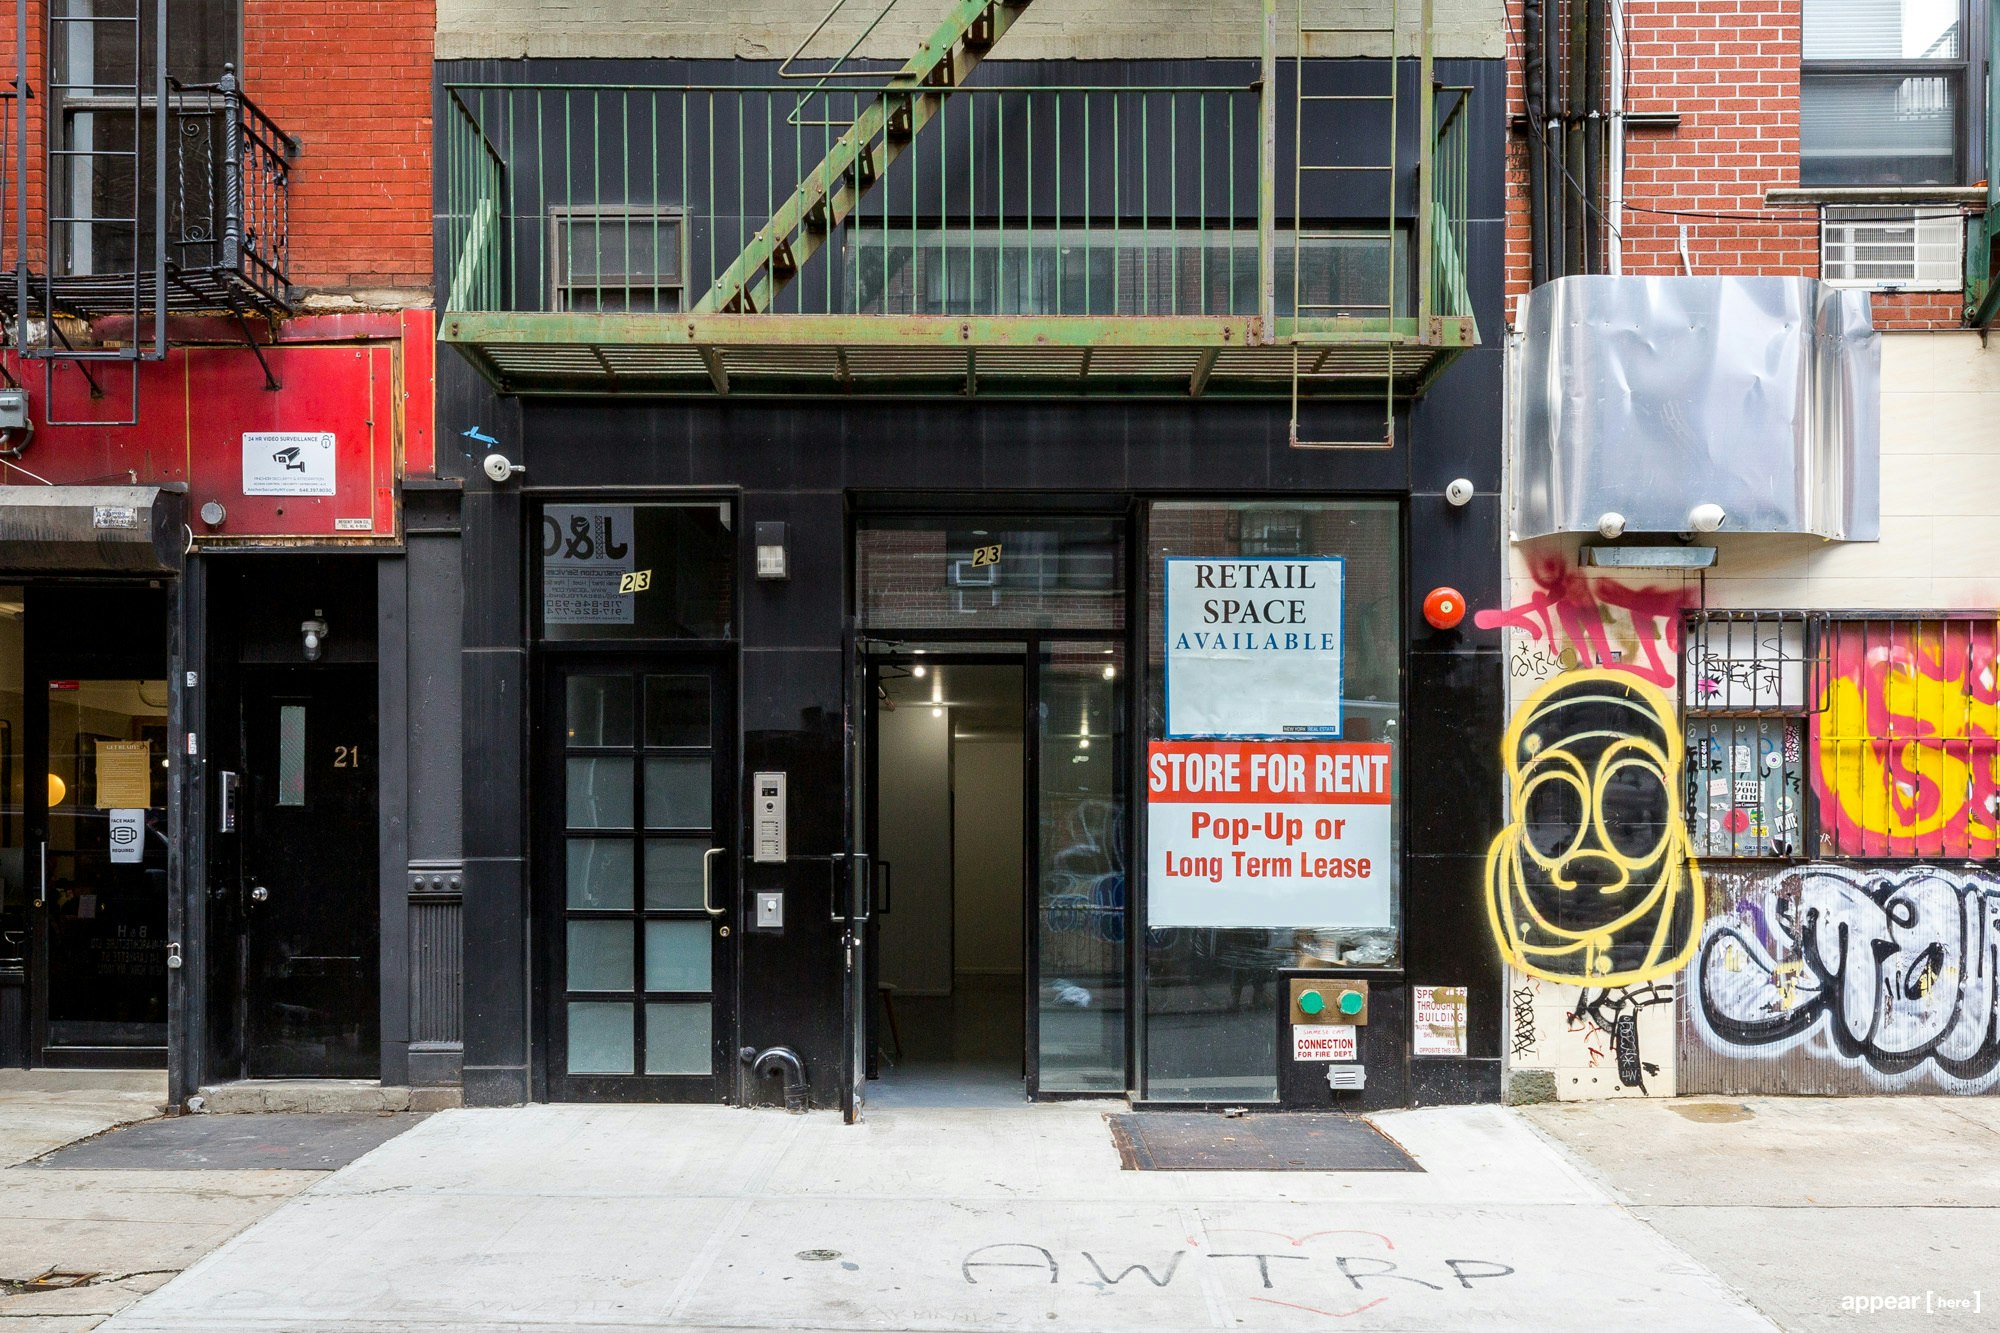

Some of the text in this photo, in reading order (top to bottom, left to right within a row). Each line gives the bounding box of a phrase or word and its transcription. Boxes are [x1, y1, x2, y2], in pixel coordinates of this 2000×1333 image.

[975, 546, 999, 565] 23
[622, 572, 648, 591] 23
[1194, 564, 1316, 589] RETAIL
[1203, 600, 1306, 624] SPACE
[1175, 632, 1334, 650] AVAILABLE
[334, 746, 358, 767] 21
[1150, 752, 1389, 793] STORE FOR RENT
[1191, 811, 1346, 846] Pop-Up or
[1166, 850, 1371, 882] Long Term Lease
[1419, 1013, 1463, 1022] BUILDING
[1298, 1039, 1353, 1049] CONNECTION
